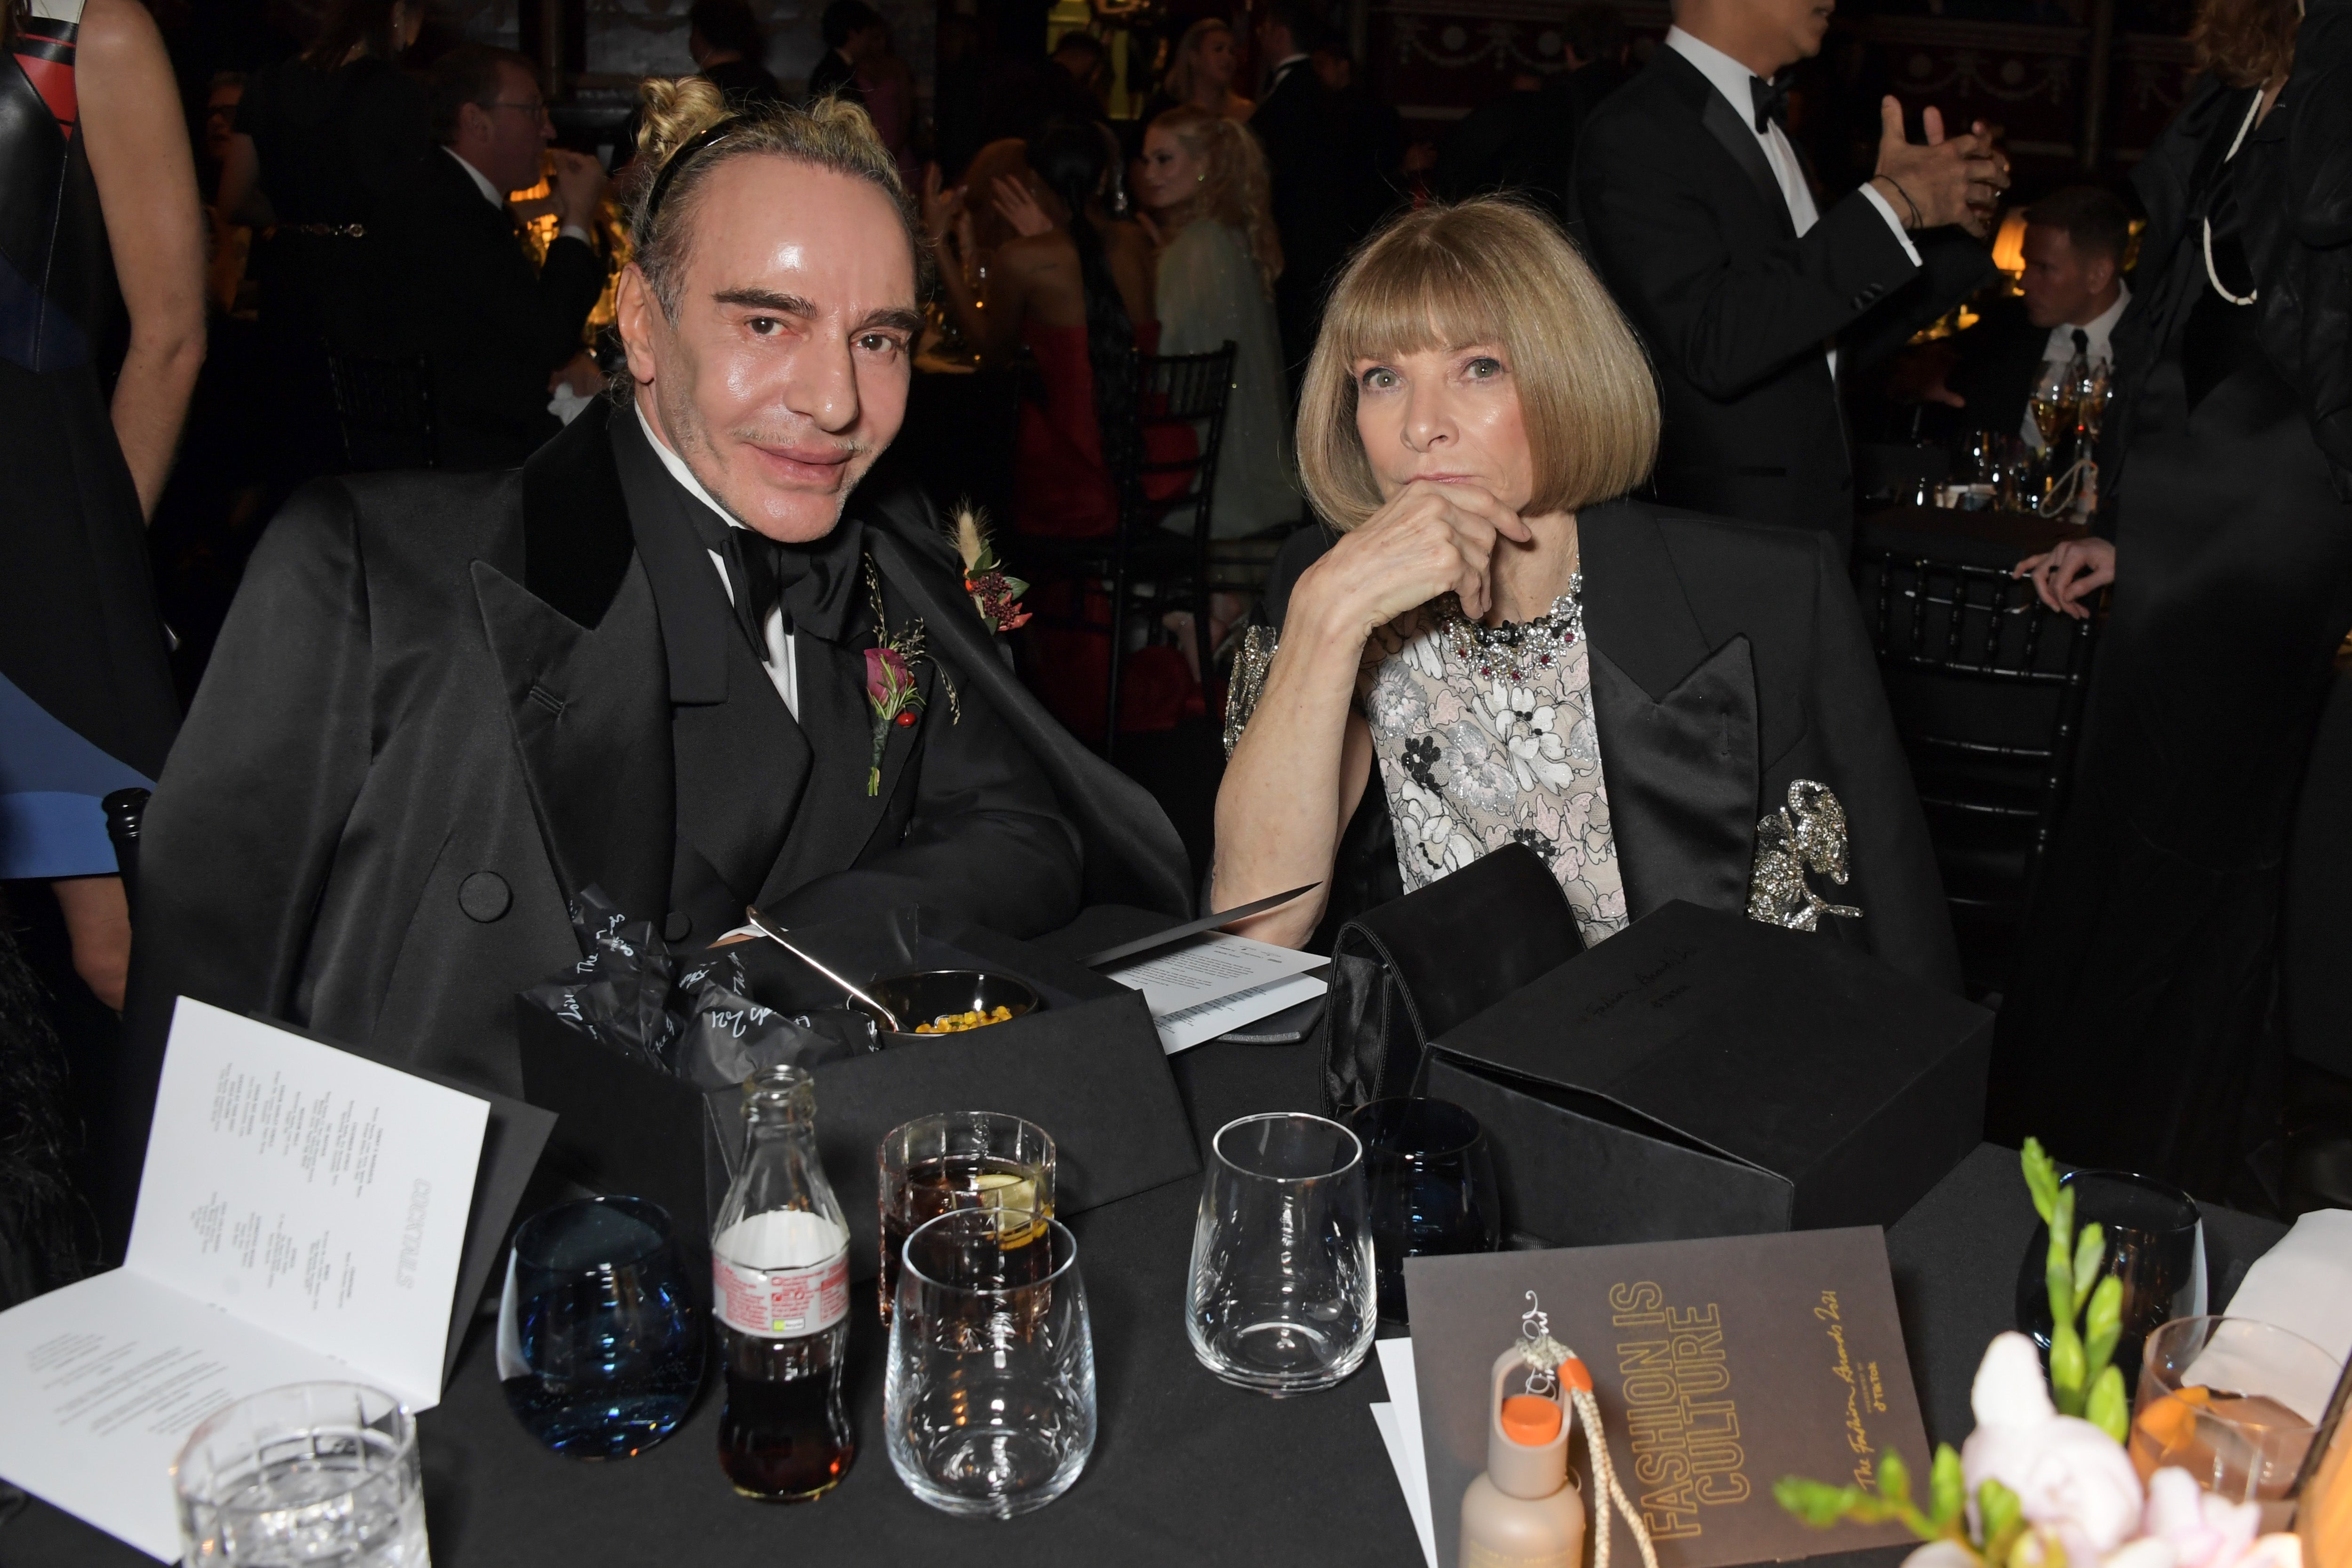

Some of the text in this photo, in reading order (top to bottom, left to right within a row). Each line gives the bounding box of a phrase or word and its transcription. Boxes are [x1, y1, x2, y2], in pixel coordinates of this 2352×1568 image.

[397, 1178, 432, 1289] COCKTAILS
[1813, 1289, 1840, 1321] 2021
[1827, 1324, 1855, 1384] Awards
[1609, 1281, 1702, 1541] FASHION IS
[1666, 1303, 1751, 1505] CULTURE
[1846, 1385, 1875, 1454] Fashion
[1853, 1458, 1876, 1491] The
